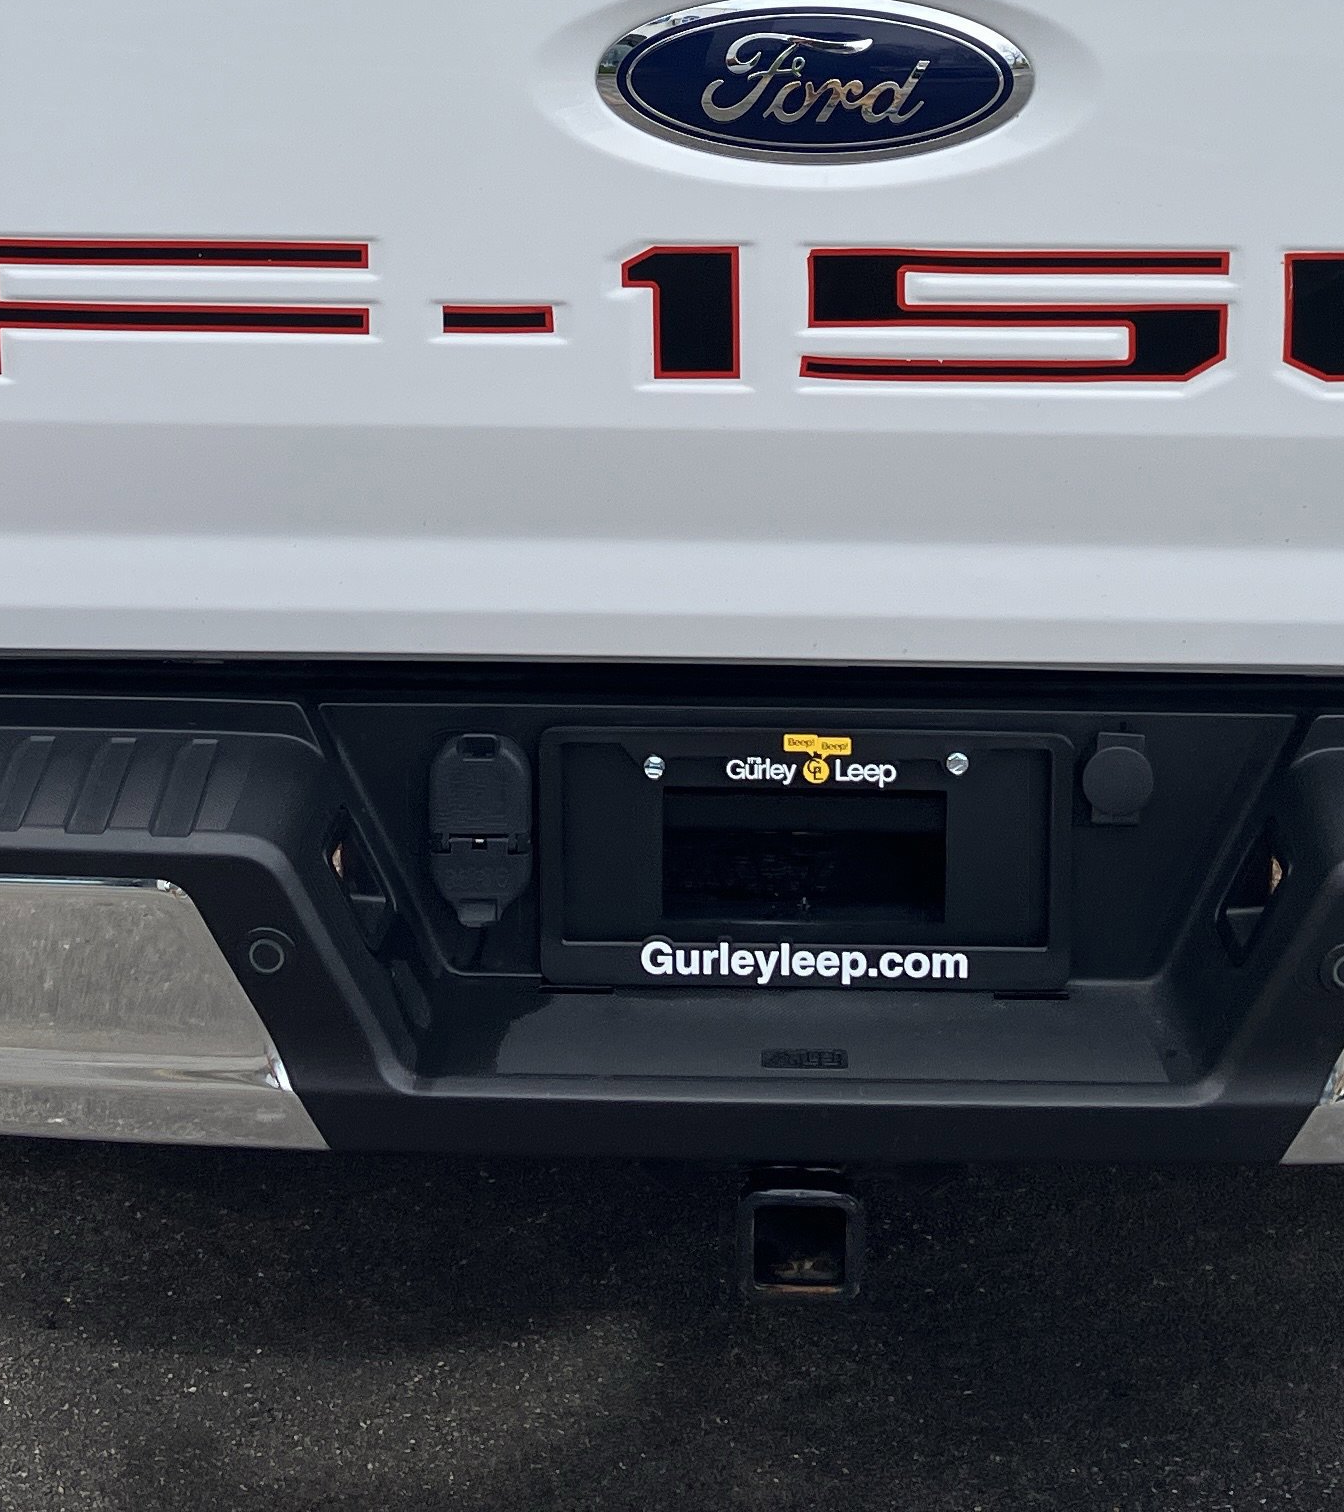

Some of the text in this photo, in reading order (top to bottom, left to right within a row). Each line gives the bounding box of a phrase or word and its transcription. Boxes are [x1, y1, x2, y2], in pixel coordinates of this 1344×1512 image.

[701, 32, 930, 124] Ford
[726, 757, 798, 785] Gurley
[835, 758, 897, 788] Leep
[640, 940, 970, 985] Gurleyleep.com
